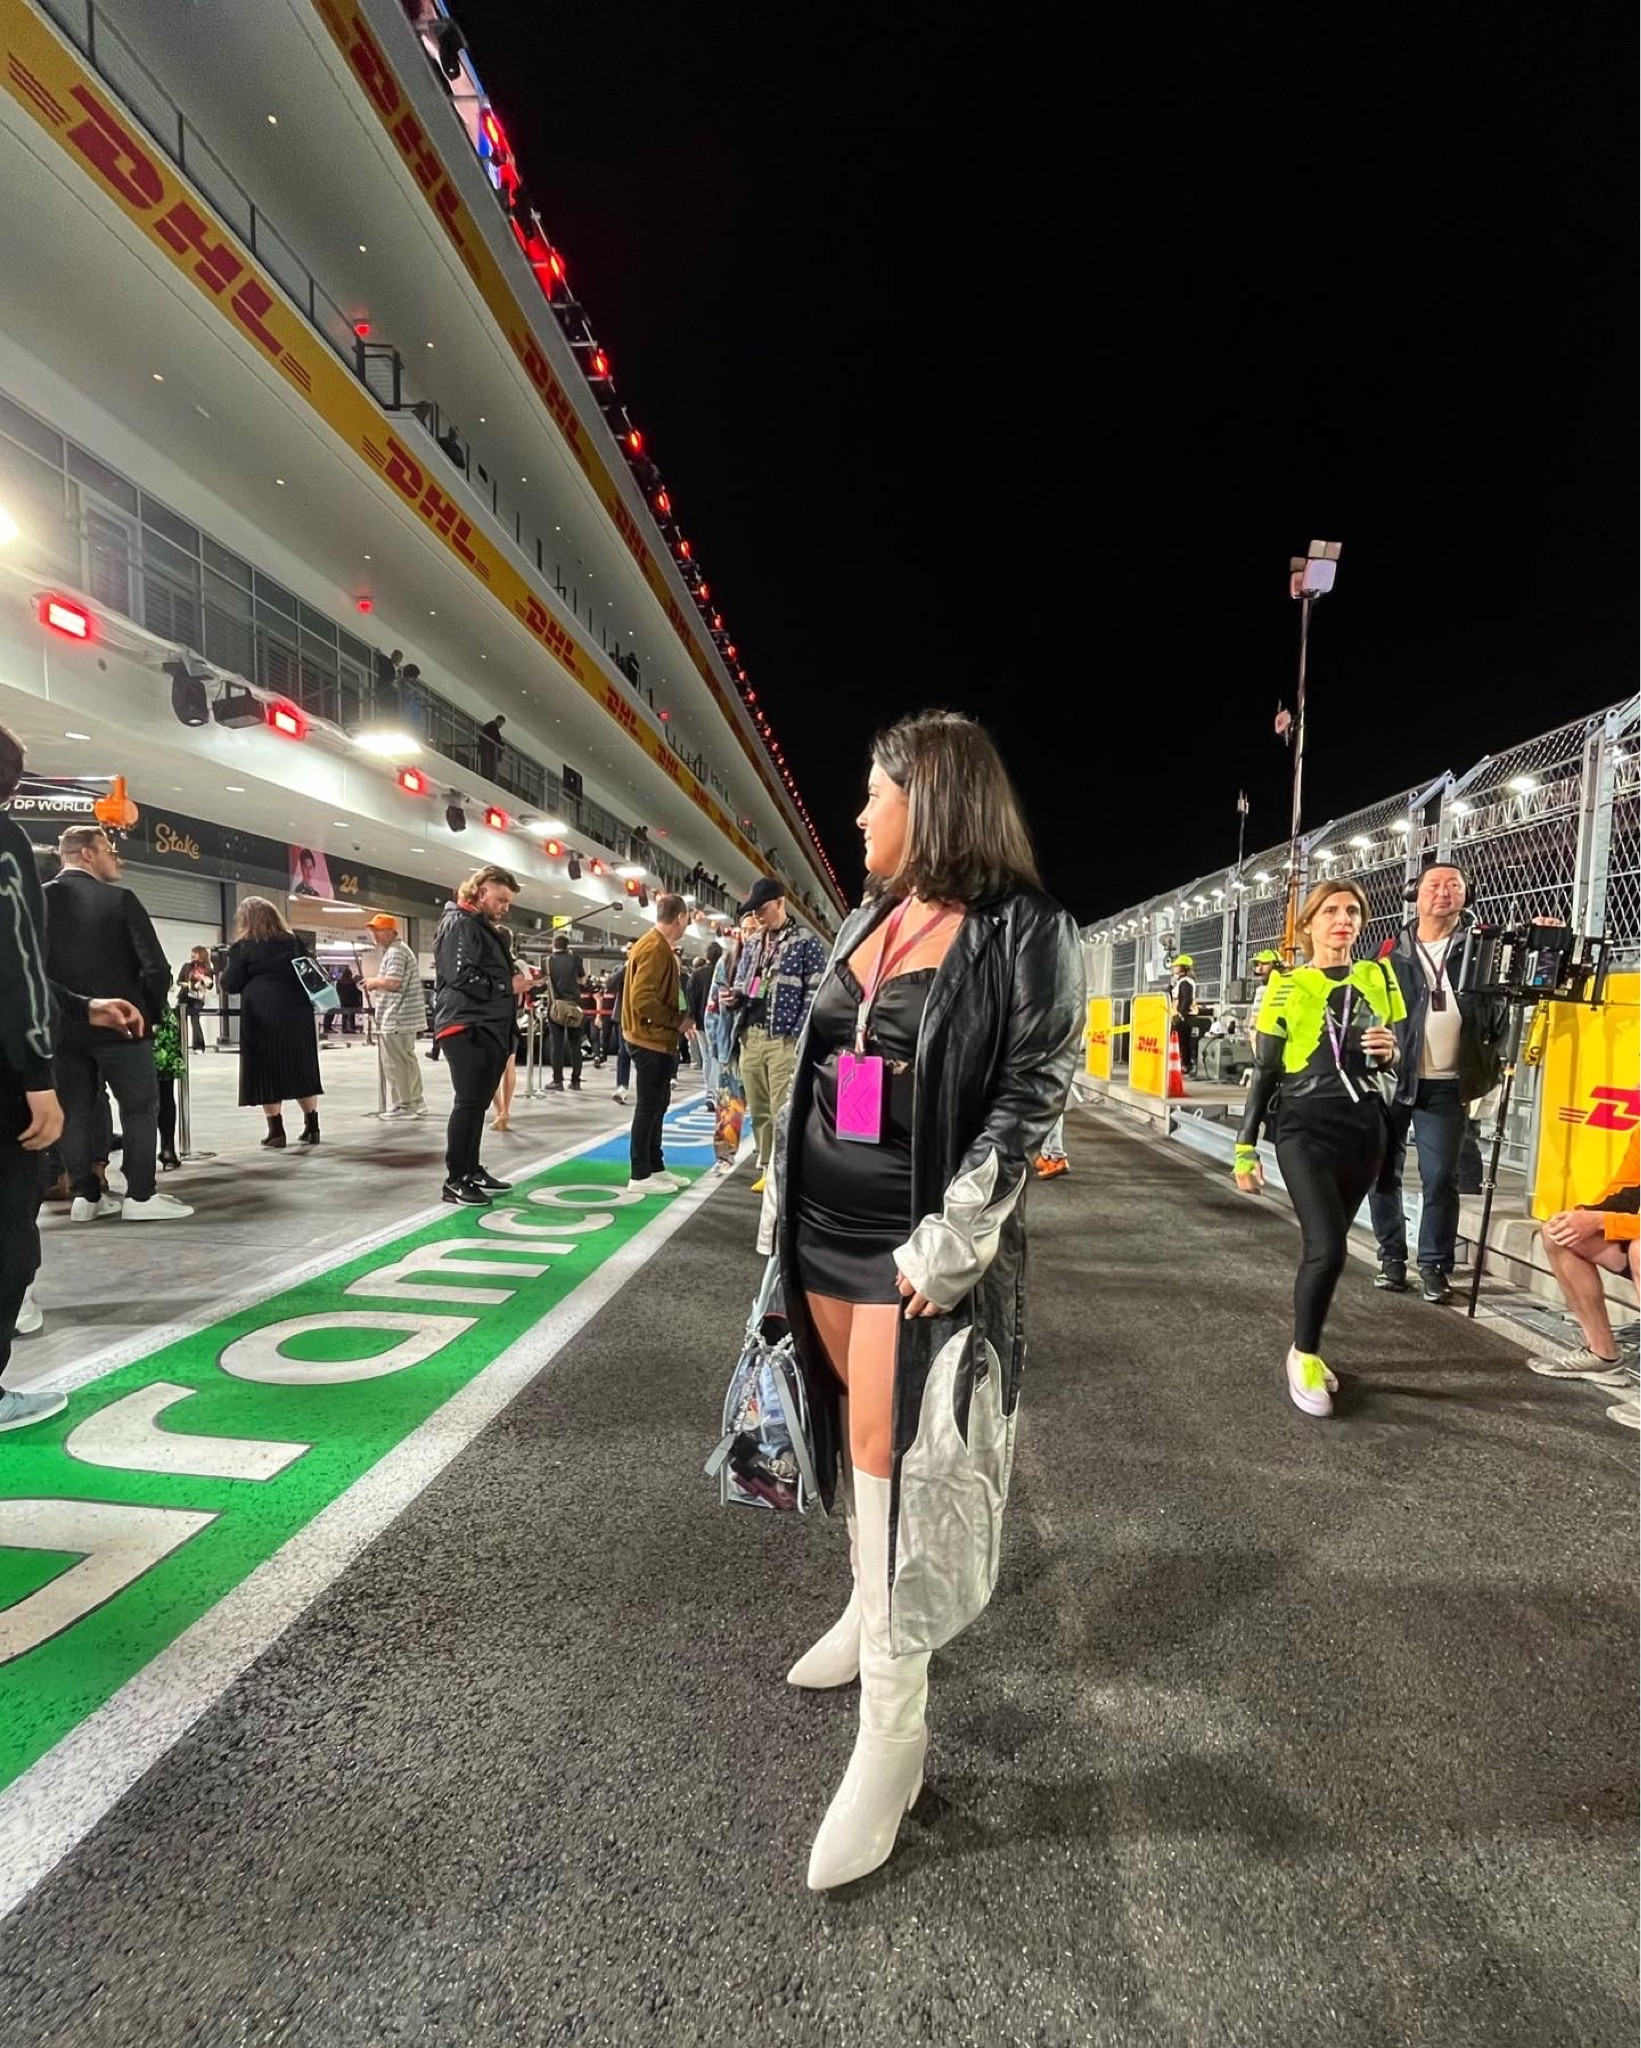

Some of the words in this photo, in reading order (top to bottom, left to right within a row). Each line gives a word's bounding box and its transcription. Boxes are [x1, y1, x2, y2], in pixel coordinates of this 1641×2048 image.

[351, 16, 465, 246] DHL
[66, 83, 284, 356] DHL
[384, 436, 477, 565] DHL
[525, 595, 577, 672] DHL
[606, 685, 639, 738] DHL
[14, 799, 36, 810] DP
[38, 800, 94, 812] WORLD
[155, 823, 200, 859] Stake
[339, 874, 359, 894] 24
